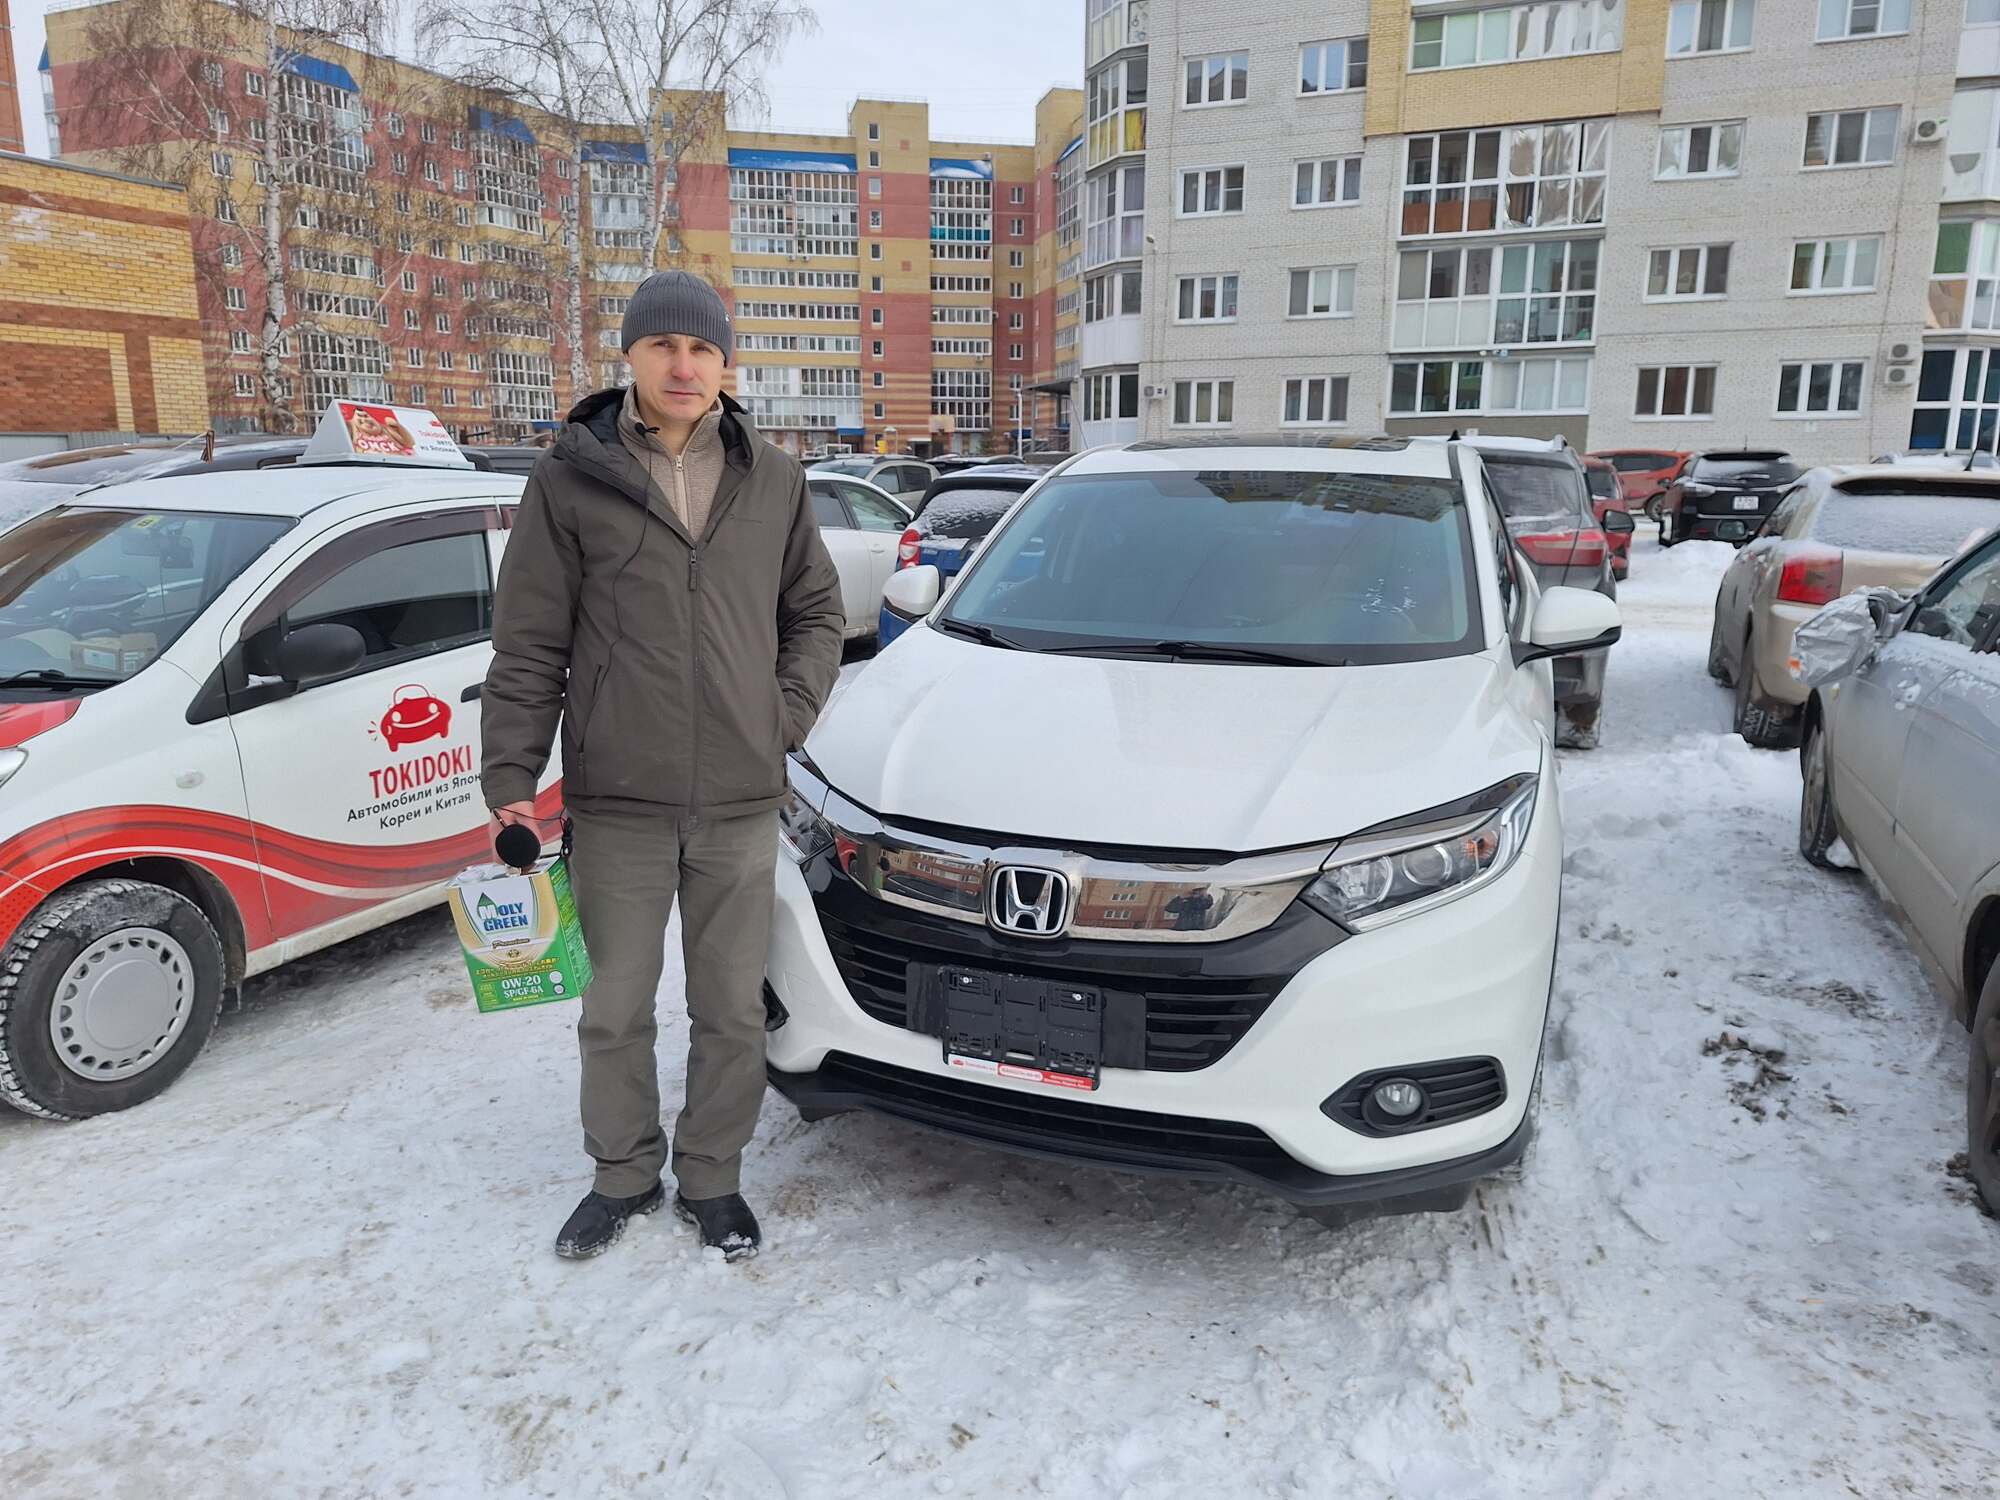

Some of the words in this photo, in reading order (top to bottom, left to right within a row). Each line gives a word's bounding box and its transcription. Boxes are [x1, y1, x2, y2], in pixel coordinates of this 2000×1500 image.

[369, 745, 473, 799] TOKIDOKI
[347, 787, 432, 822] Автомобили
[435, 784, 449, 796] из
[452, 773, 482, 790] Япон
[379, 810, 421, 830] Кореи
[424, 806, 432, 816] и
[435, 791, 471, 811] Китая
[478, 902, 523, 920] MOLY
[483, 914, 528, 932] GREEN
[501, 975, 542, 990] 0W-20
